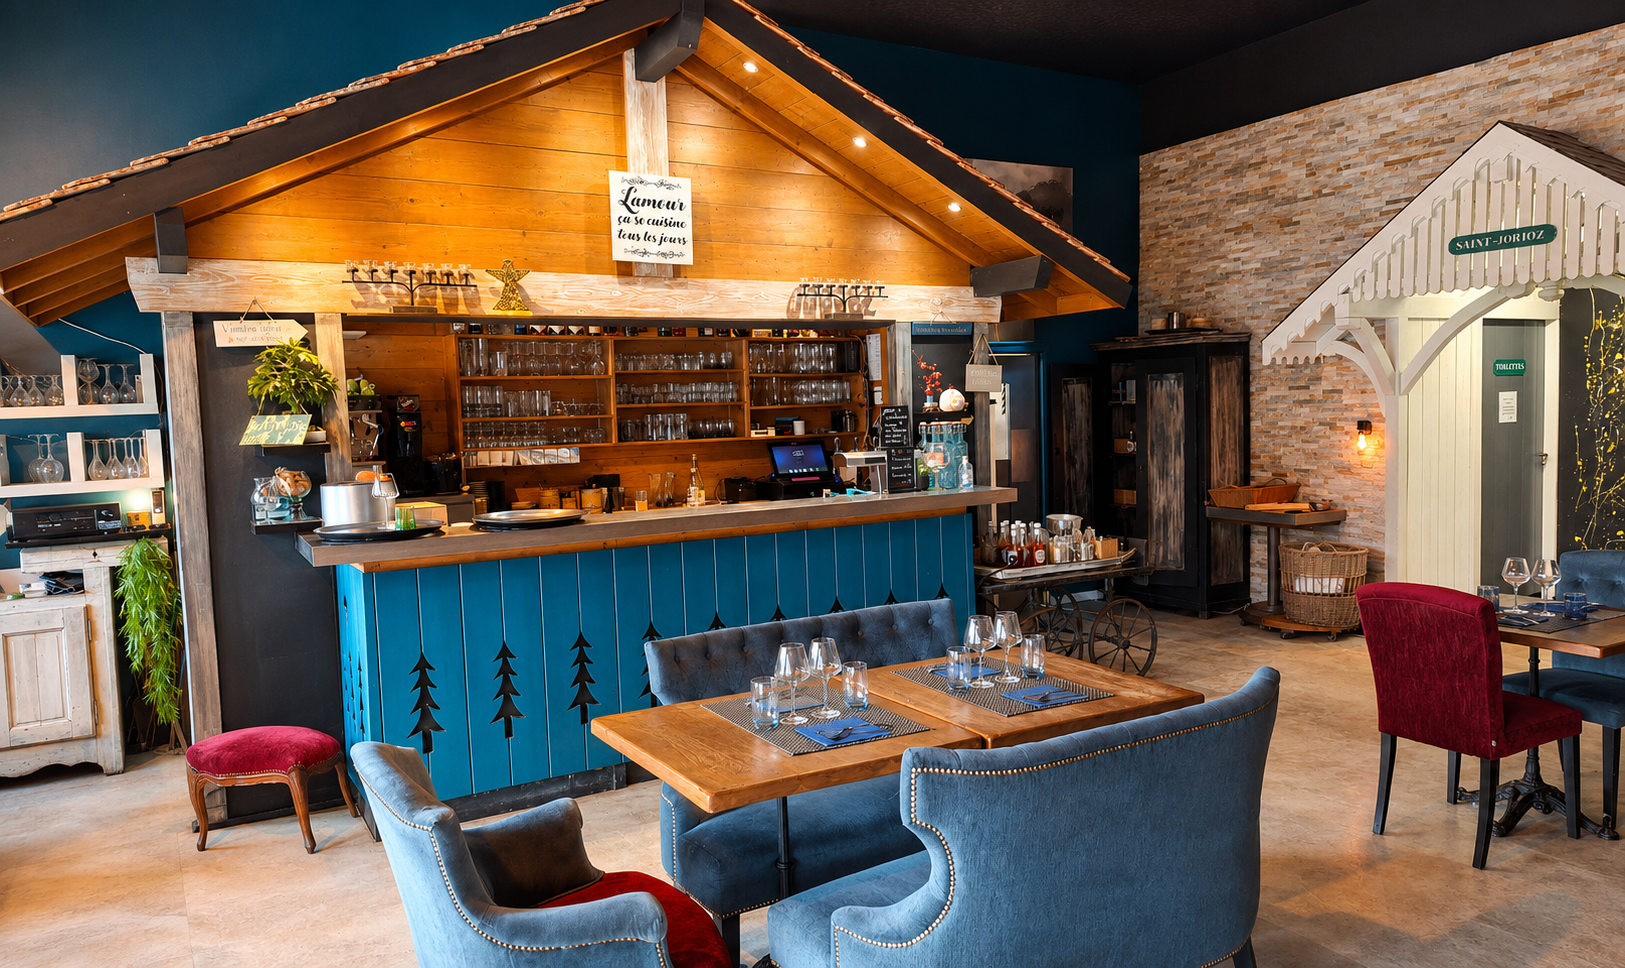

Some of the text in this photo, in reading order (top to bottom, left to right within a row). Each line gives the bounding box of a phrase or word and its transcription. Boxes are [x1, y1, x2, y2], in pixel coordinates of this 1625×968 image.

[617, 215, 631, 225] ça
[617, 228, 688, 246] tous les jours
[1455, 229, 1545, 251] SAINT-JORIOZ
